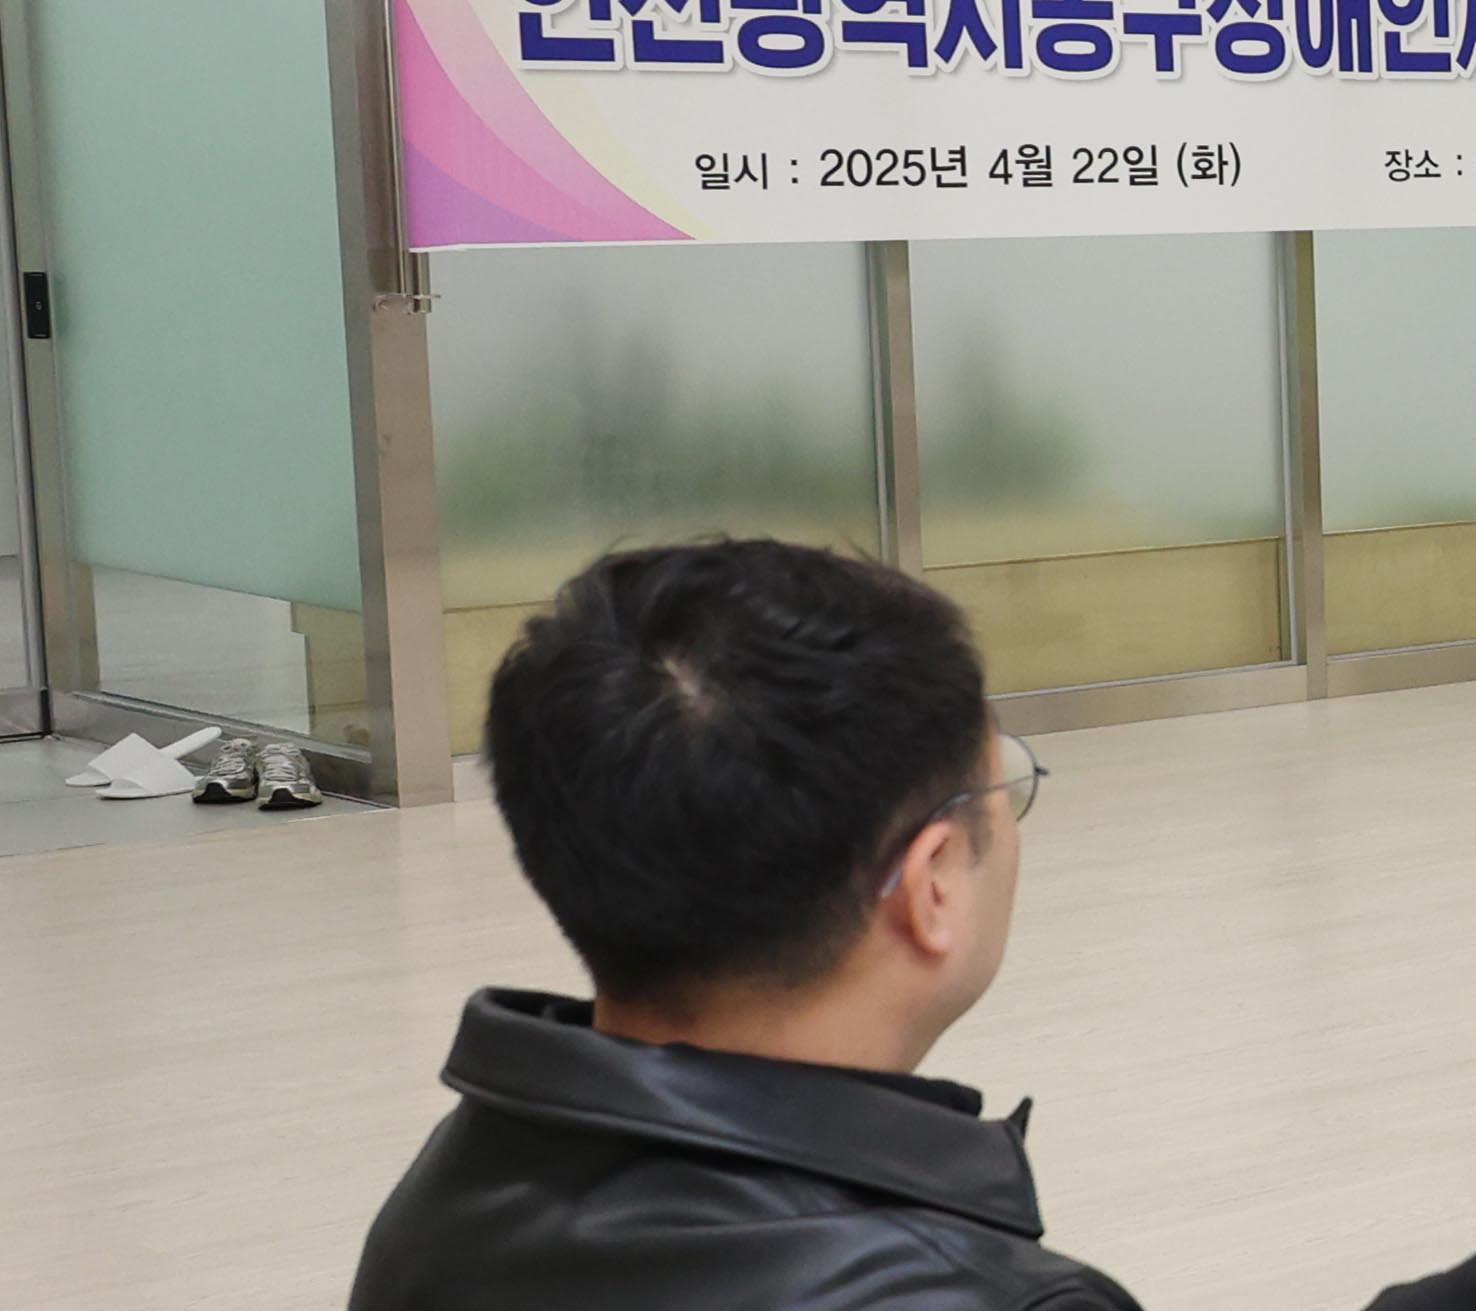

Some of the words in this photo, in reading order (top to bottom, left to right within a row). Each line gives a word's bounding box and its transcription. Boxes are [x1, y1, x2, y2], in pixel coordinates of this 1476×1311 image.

[694, 151, 770, 190] 일시
[790, 158, 800, 185] :
[819, 145, 969, 189] 2025년
[987, 143, 1053, 188] 4월
[1071, 142, 1159, 187] 22일
[1176, 141, 1242, 188] (화)
[1383, 149, 1442, 182] 장소
[1456, 152, 1464, 176] :
